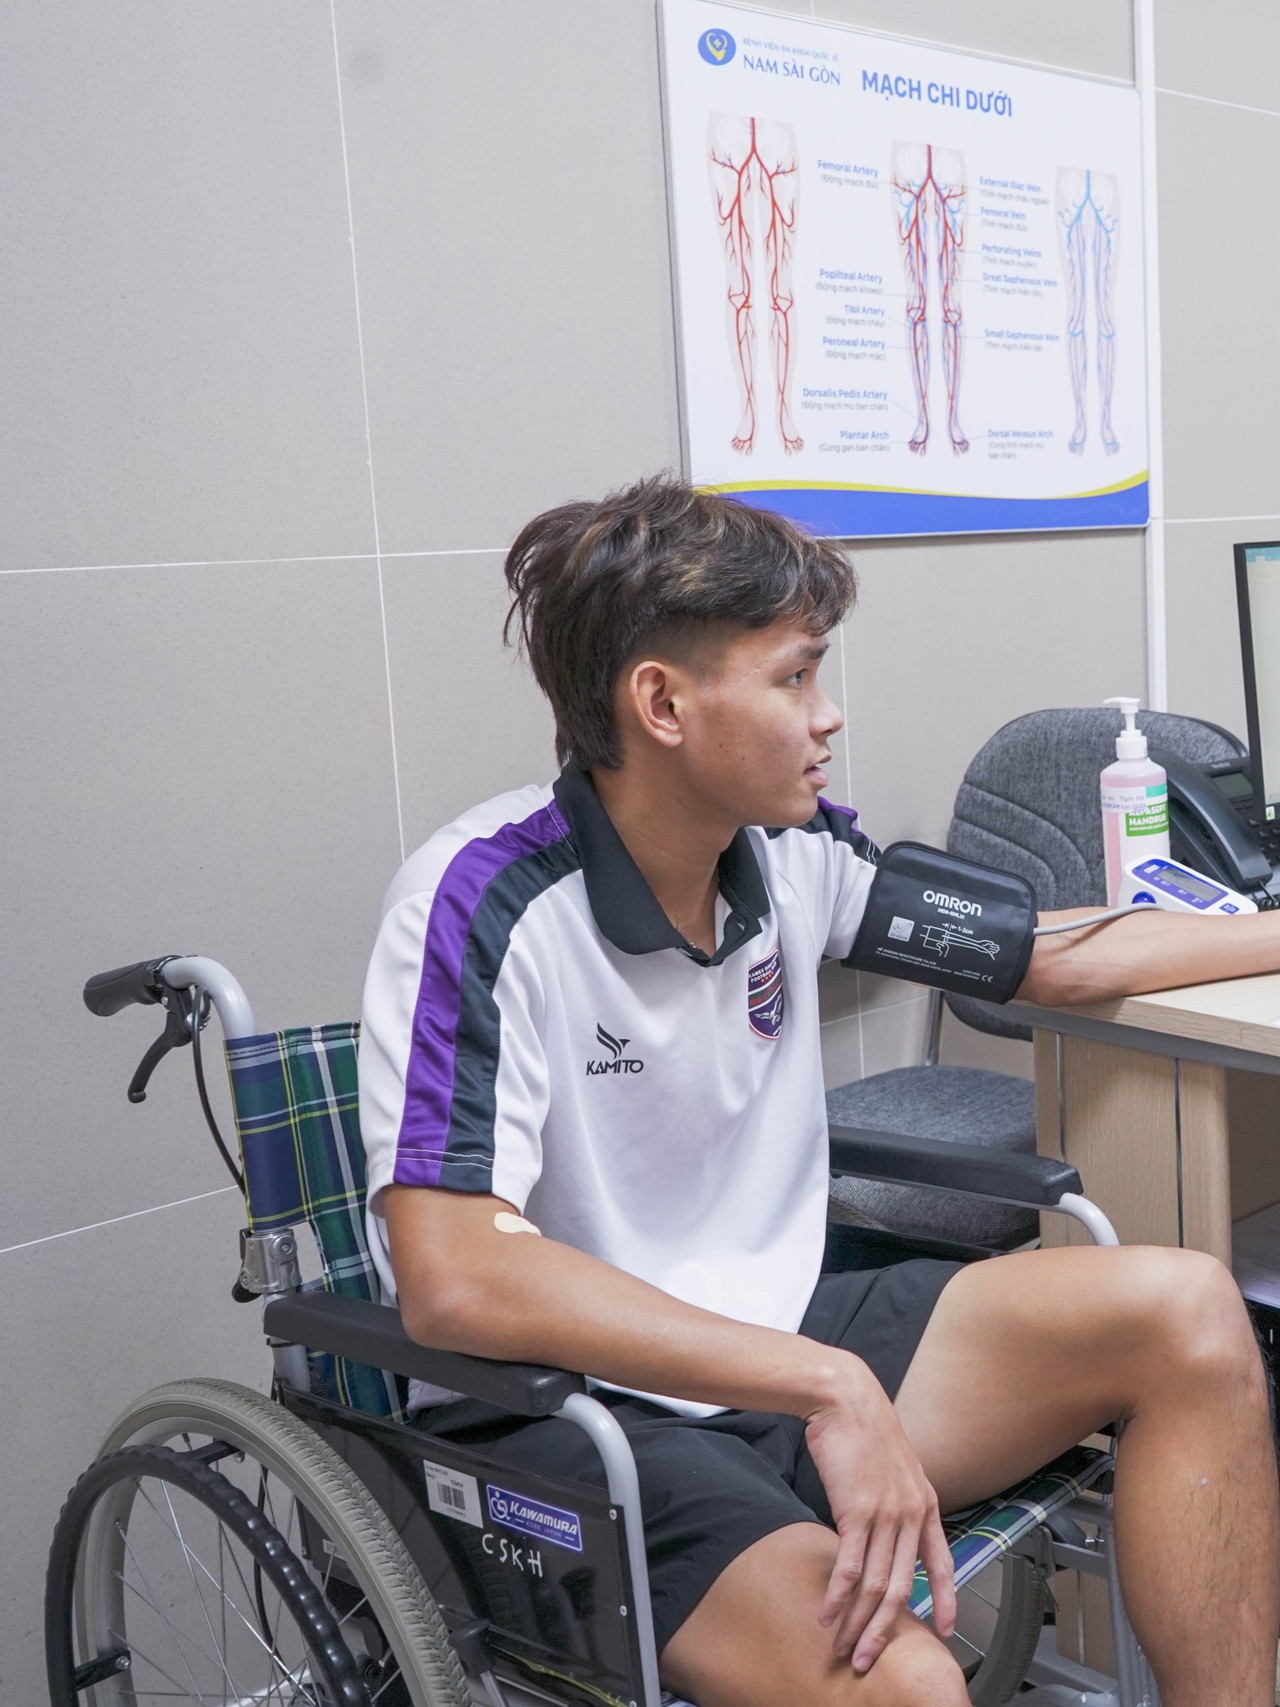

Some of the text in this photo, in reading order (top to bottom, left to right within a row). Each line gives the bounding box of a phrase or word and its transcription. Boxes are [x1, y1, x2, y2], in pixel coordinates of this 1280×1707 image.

[743, 54, 841, 86] NAM SÀI GÒN
[862, 70, 1012, 117] MẠCH CHI DƯỚI
[818, 160, 878, 178] Femoral Artery
[981, 206, 1026, 220] Femoral Vein
[820, 269, 883, 284] Popliteal Artery
[862, 306, 884, 317] Artery
[823, 336, 885, 350] Peroneal Artery
[803, 388, 888, 400] Dorsalis Pedis Artery
[840, 430, 889, 439] Plantar Arch
[923, 890, 982, 916] OMRON
[586, 1060, 644, 1076] KAMITO
[510, 1501, 577, 1535] KAWAMURA
[544, 1528, 562, 1538] JAPAN
[482, 1534, 543, 1578] CSKH
